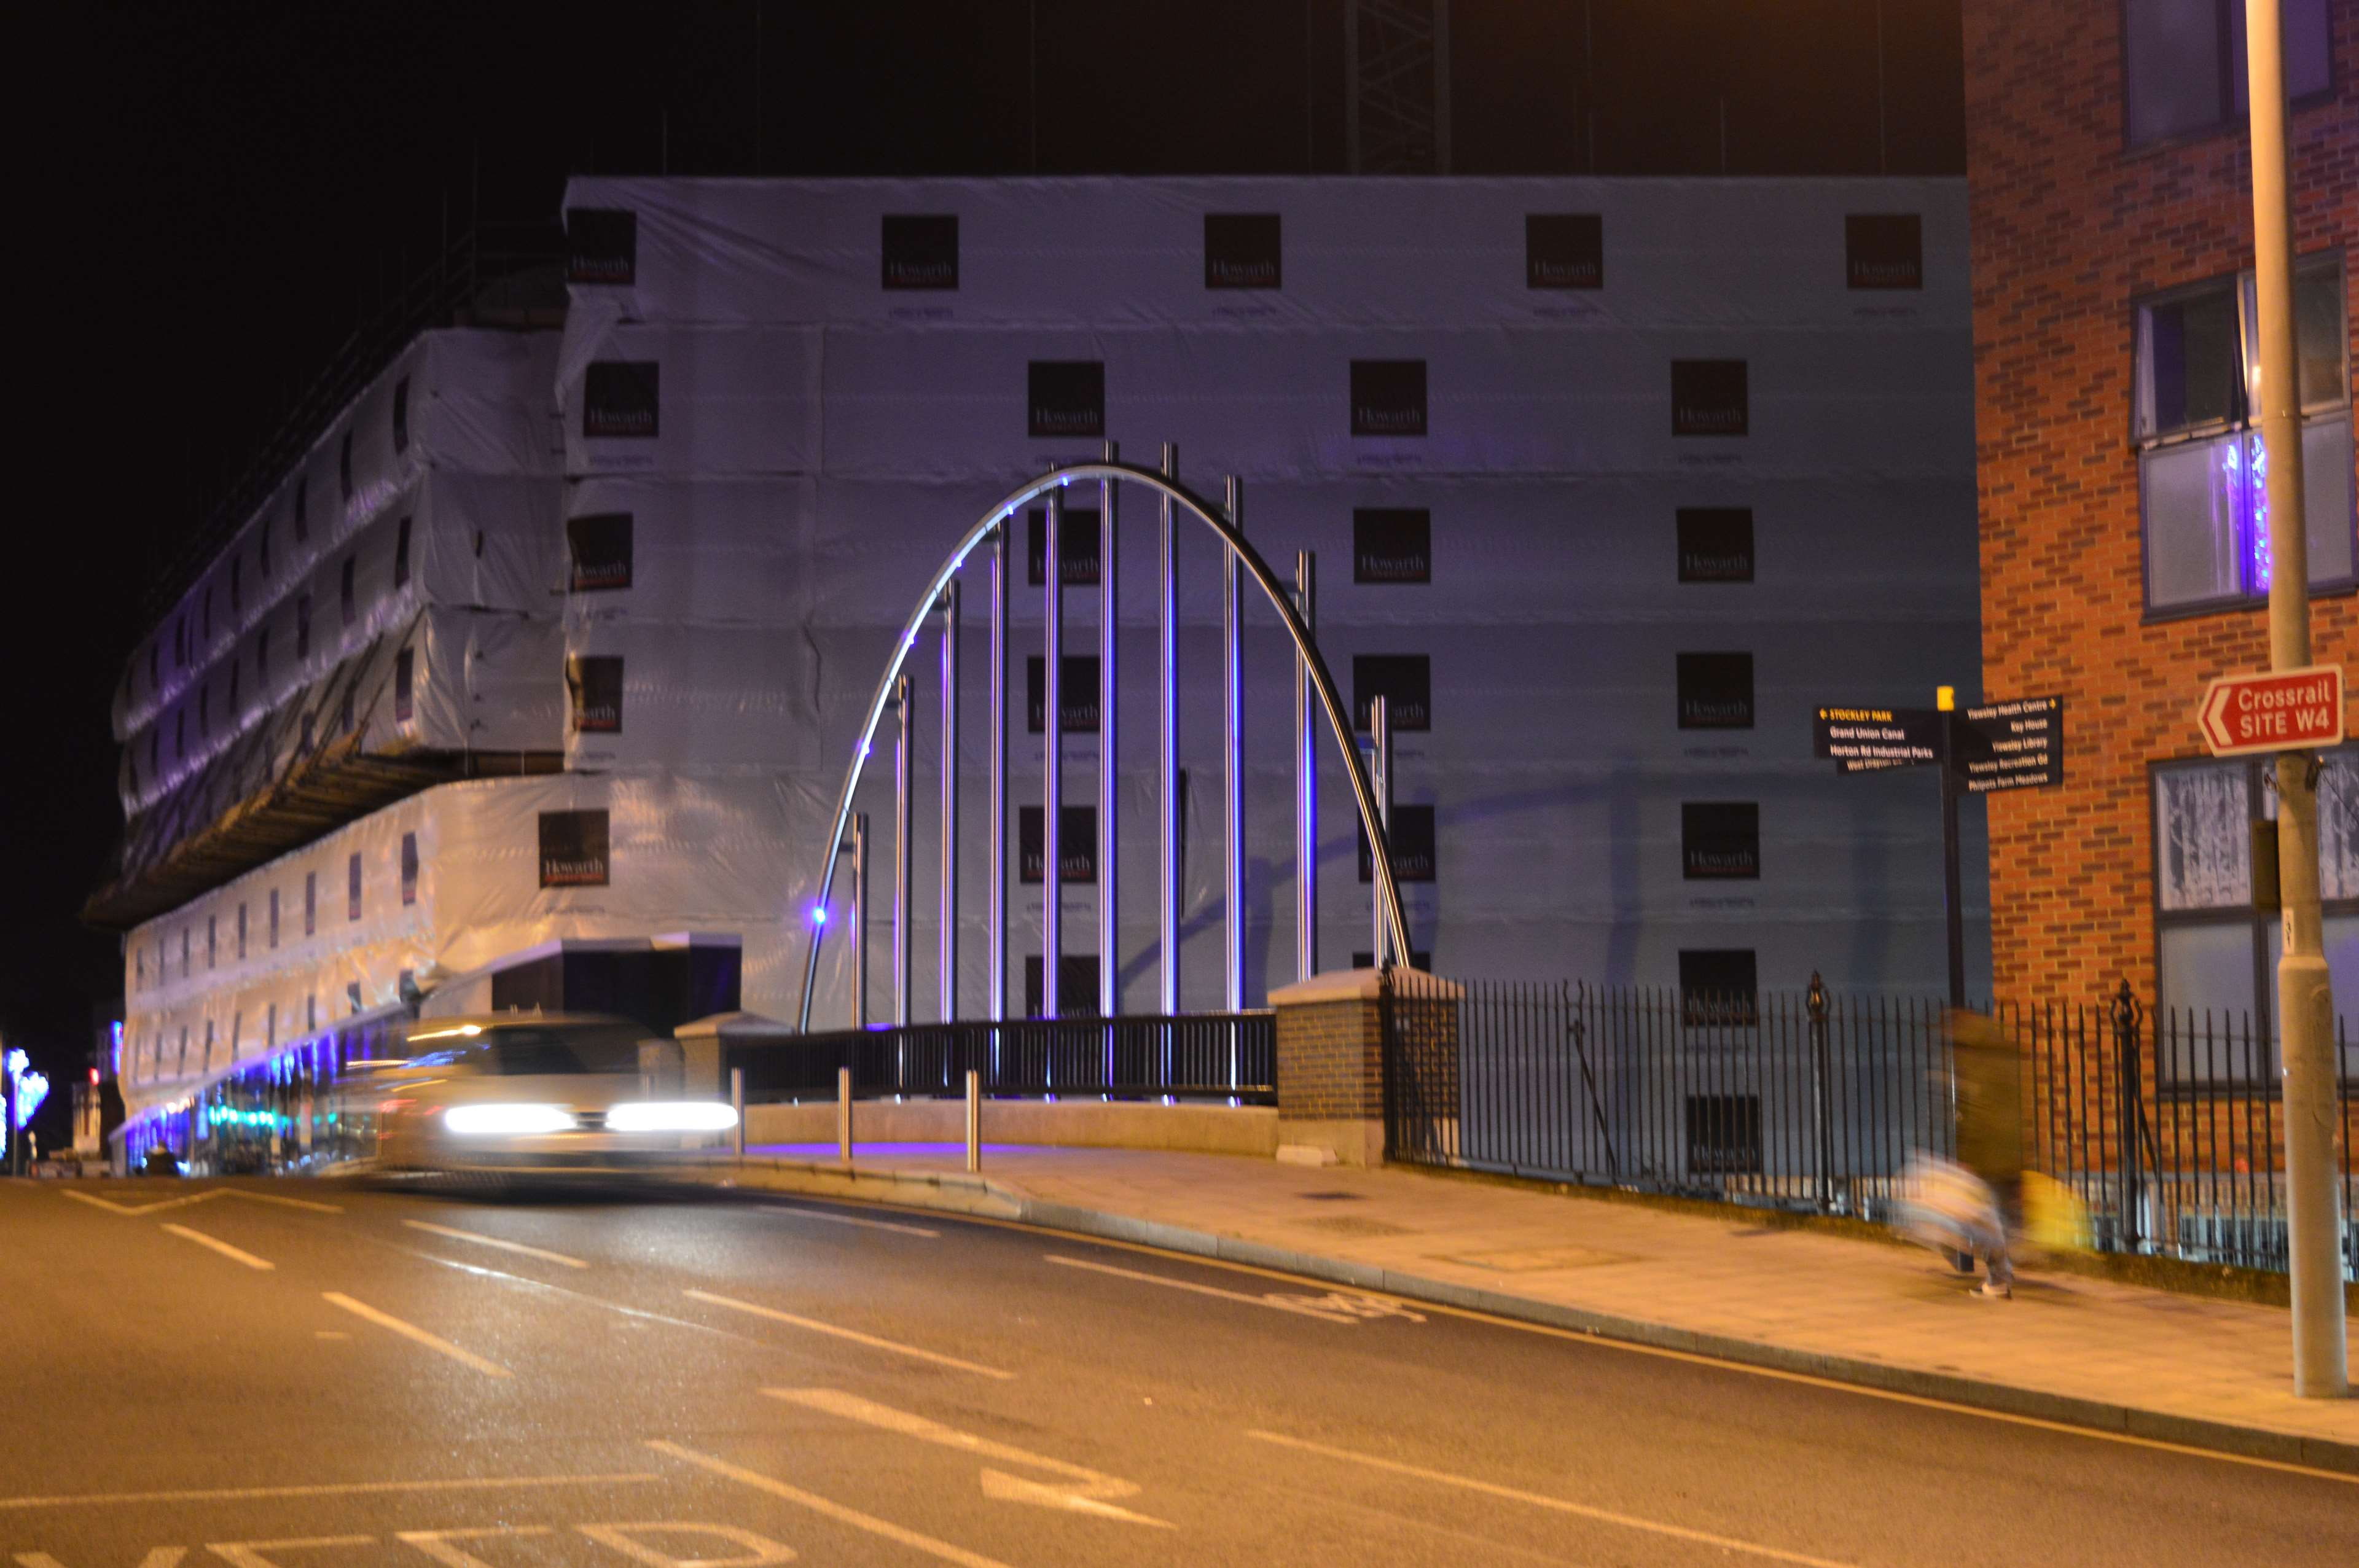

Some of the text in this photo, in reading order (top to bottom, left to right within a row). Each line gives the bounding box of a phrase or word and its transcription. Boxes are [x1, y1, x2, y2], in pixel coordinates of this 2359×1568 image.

[572, 254, 629, 272] Howarth
[890, 260, 952, 276] Howarth
[1212, 259, 1275, 276] Howarth
[1534, 260, 1597, 276] Howarth
[1853, 260, 1916, 276] Howarth
[589, 408, 652, 424] Howarth
[1036, 408, 1098, 424] Howarth
[1358, 407, 1421, 424] Howarth
[1679, 407, 1742, 423] Howarth
[1361, 554, 1424, 571] Howarth
[1684, 554, 1747, 570] Howarth
[2238, 678, 2331, 711] Crossrail
[1684, 701, 1747, 716] Howarth
[1829, 708, 1893, 722] STOCKLEY PARK
[1998, 703, 2021, 716] Health
[2022, 700, 2048, 712] Centre
[2025, 718, 2048, 731] House
[2240, 706, 2330, 738] SITE W4
[1829, 726, 1905, 741] Grand Union Canal
[2023, 737, 2048, 749] Library
[1830, 744, 1933, 759] Horton Rd Industrial Parks
[1691, 850, 1753, 866] Howarth
[545, 858, 603, 875] Howarth
